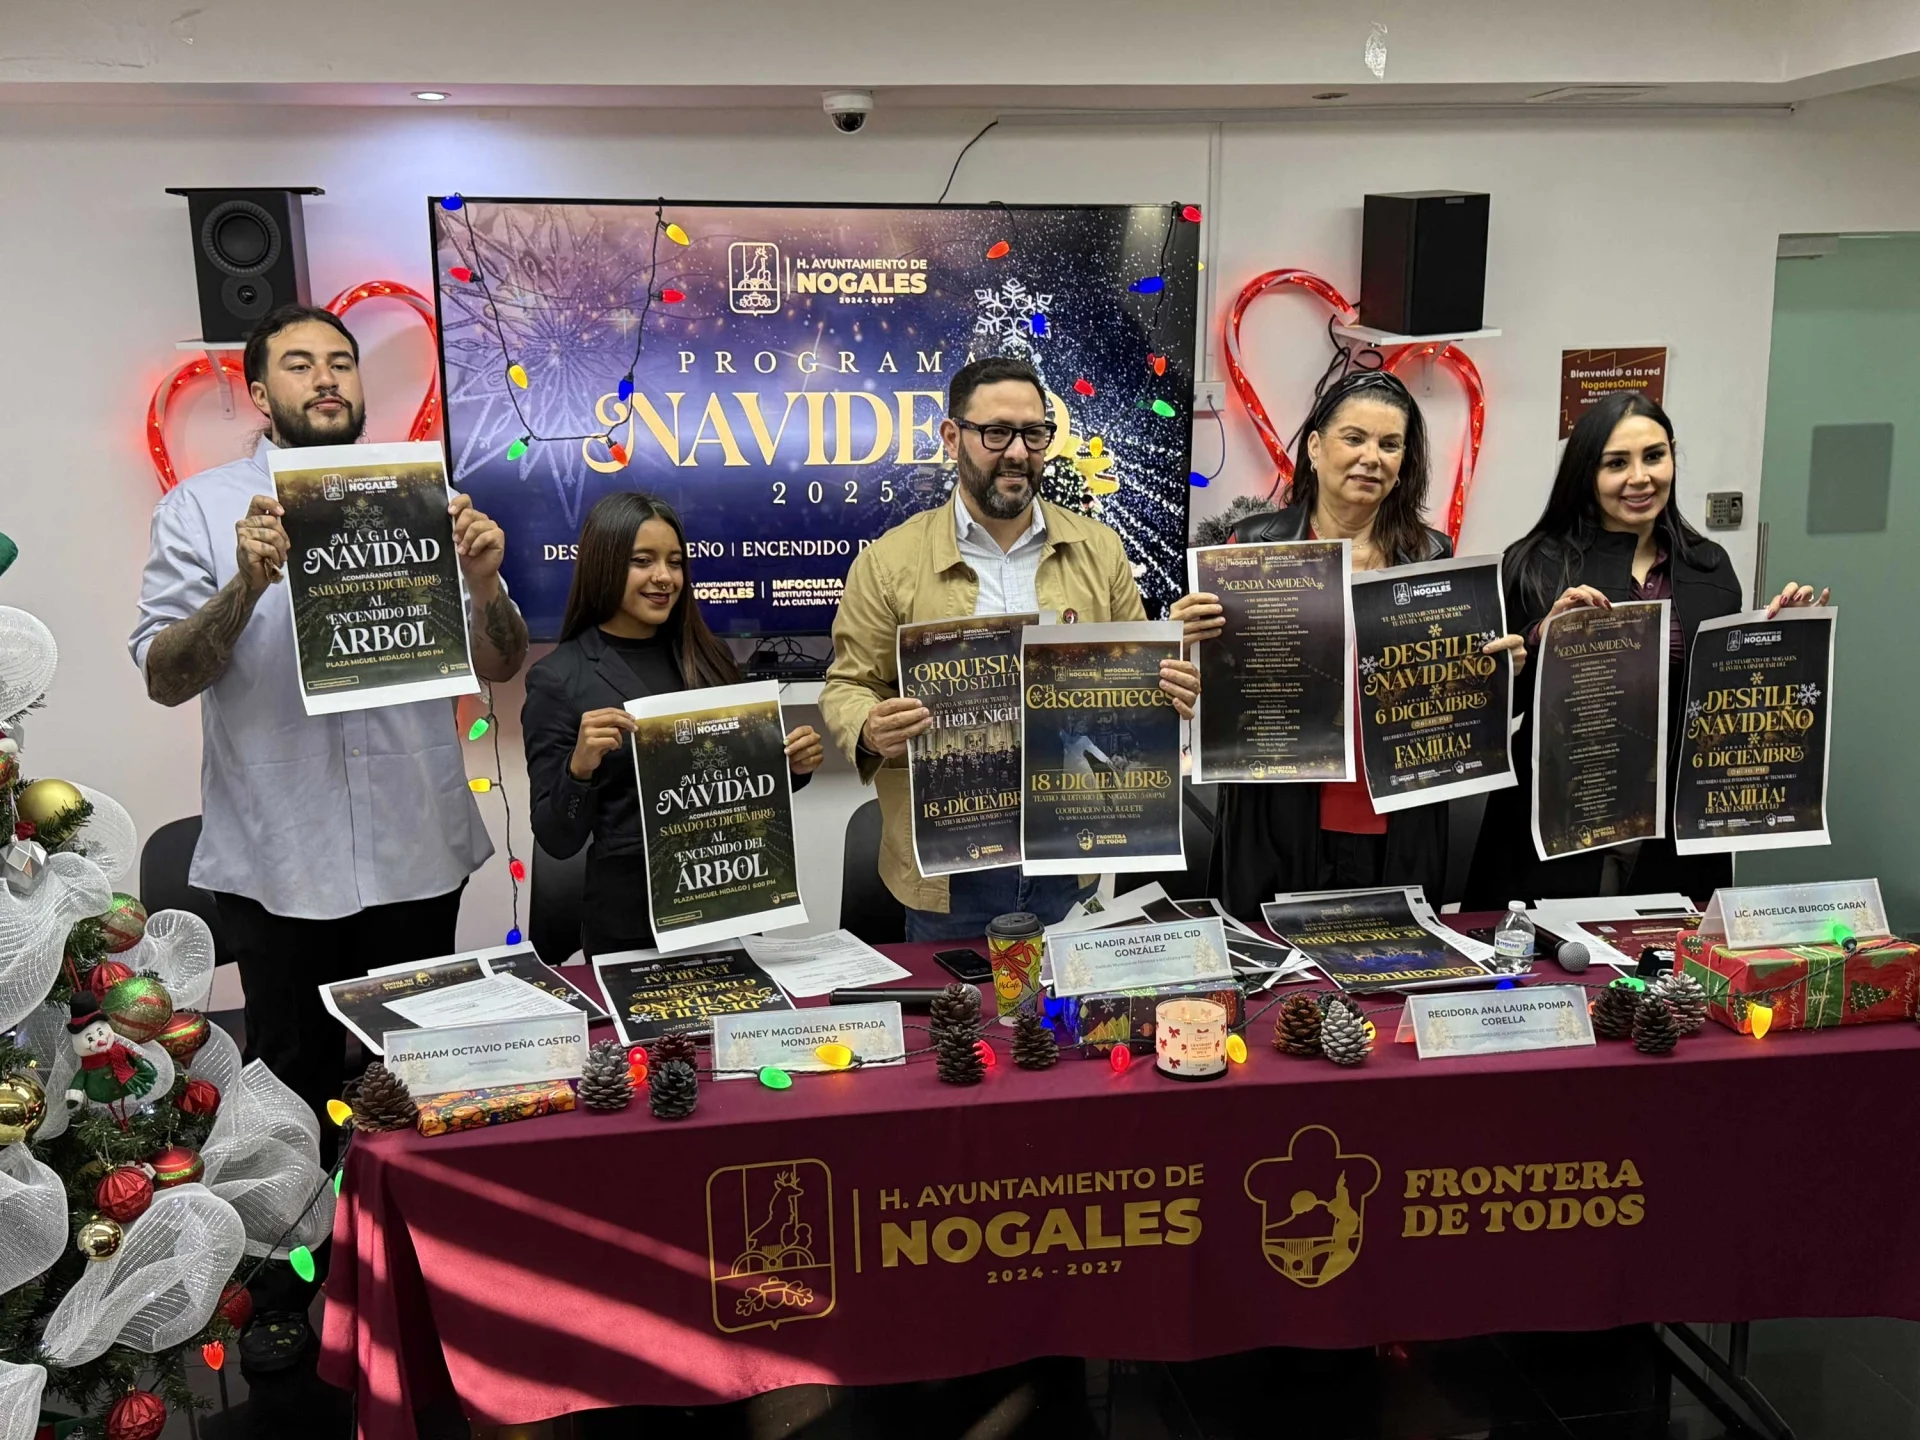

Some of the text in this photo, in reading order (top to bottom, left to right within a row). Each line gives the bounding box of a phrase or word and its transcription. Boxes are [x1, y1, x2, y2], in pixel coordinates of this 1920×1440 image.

[797, 258, 927, 269] H. AYUNTAMIENTO DE
[797, 272, 928, 294] NOGALES
[839, 296, 895, 304] 2024 2027
[1633, 368, 1643, 376] la
[1644, 367, 1660, 376] red
[1581, 380, 1648, 390] NogalesOnline
[582, 390, 1071, 473] NAVIDE
[348, 480, 398, 492] NOGALES
[772, 481, 894, 504] 2025
[330, 528, 410, 546] MÁGICA
[303, 538, 440, 575] NAVIDAD
[743, 540, 850, 557] ENCENDIDO
[393, 569, 409, 577] ESTE
[1223, 576, 1317, 591] AGENDA NAVIDEÑA
[308, 574, 441, 598] SÁBADO 13 DICIEMBRE
[772, 578, 844, 590] IMFOCULTA
[773, 590, 812, 598] INSTITUTO
[1413, 585, 1451, 597] NOGALES
[368, 595, 386, 608] AL
[791, 598, 827, 606] CULTURA
[1446, 604, 1471, 612] NOGALES
[325, 604, 431, 625] ENCENDIDO DEL
[326, 621, 436, 657] ÁRBOL
[1744, 634, 1781, 644] NOGALES
[326, 660, 350, 668] PLAZA
[351, 657, 378, 666] MIGUEL
[379, 653, 410, 662] HIDALGO
[417, 650, 432, 658] 6:00
[1379, 633, 1480, 670] DESFILE
[908, 654, 1021, 683] ORQUESTA
[1364, 654, 1497, 696] NAVIDEÑO
[907, 673, 1019, 697] SAN JOSELIT
[1026, 684, 1175, 709] Cascanueces
[1702, 685, 1799, 714] DESFILE
[958, 703, 1012, 713] MUSICALIZADA
[1375, 709, 1386, 725] 6
[1391, 692, 1487, 722] DICIEMBRE
[697, 721, 740, 735] NOGALES
[945, 711, 979, 728] HOLY
[1687, 705, 1814, 739] NAVIDEÑO
[1395, 732, 1471, 762] FAMILIA!
[1692, 753, 1703, 768] 6
[1708, 746, 1804, 767] DICIEMBRE
[680, 766, 750, 787] MÁGICA
[1031, 770, 1171, 791] 18 DICIEMBRE
[656, 774, 775, 815] NAVIDAD
[959, 787, 997, 798] JUEVES
[1707, 786, 1786, 807] FAMILIA!
[923, 791, 1021, 818] 18 DICIEMBR
[660, 808, 776, 837] SÁBADO 13 DICIEMBRE
[934, 819, 955, 827] TEATRO
[711, 831, 726, 843] AL
[674, 837, 766, 862] ENCENDIDO DEL
[675, 853, 768, 894] ÁRBOL
[673, 896, 694, 904] PLAZA
[694, 891, 718, 900] MIGUEL
[719, 885, 747, 895] HIDALGO
[1752, 907, 1796, 917] ANGELICA
[1799, 903, 1835, 913] BURGOS
[1837, 901, 1867, 910] GARAY
[1075, 929, 1201, 951] LIC. NADIR ALTAIR DEL CID
[1114, 944, 1166, 958] GONZÁLEZ
[1332, 965, 1485, 982] Cascanueces
[632, 980, 739, 999] DICIEMBRE
[652, 999, 762, 1021] DESFILE
[1428, 1000, 1574, 1019] REGIDORA ANA LAURA POMPA
[730, 1020, 886, 1040] VIANEY MAGDALENA ESTRADA
[1481, 1015, 1526, 1026] CORELLA
[391, 1034, 581, 1063] ABRAHAM OCTAVIO PEÑA CASTRO
[781, 1035, 839, 1047] MONJARAZ
[880, 1163, 1204, 1210] H. AYUNTAMIENTO DE
[1403, 1159, 1644, 1198] FRONTERA
[1401, 1194, 1645, 1237] DE TODOS
[881, 1198, 1203, 1267] NOGALES
[987, 1260, 1123, 1283] 2024 2027
